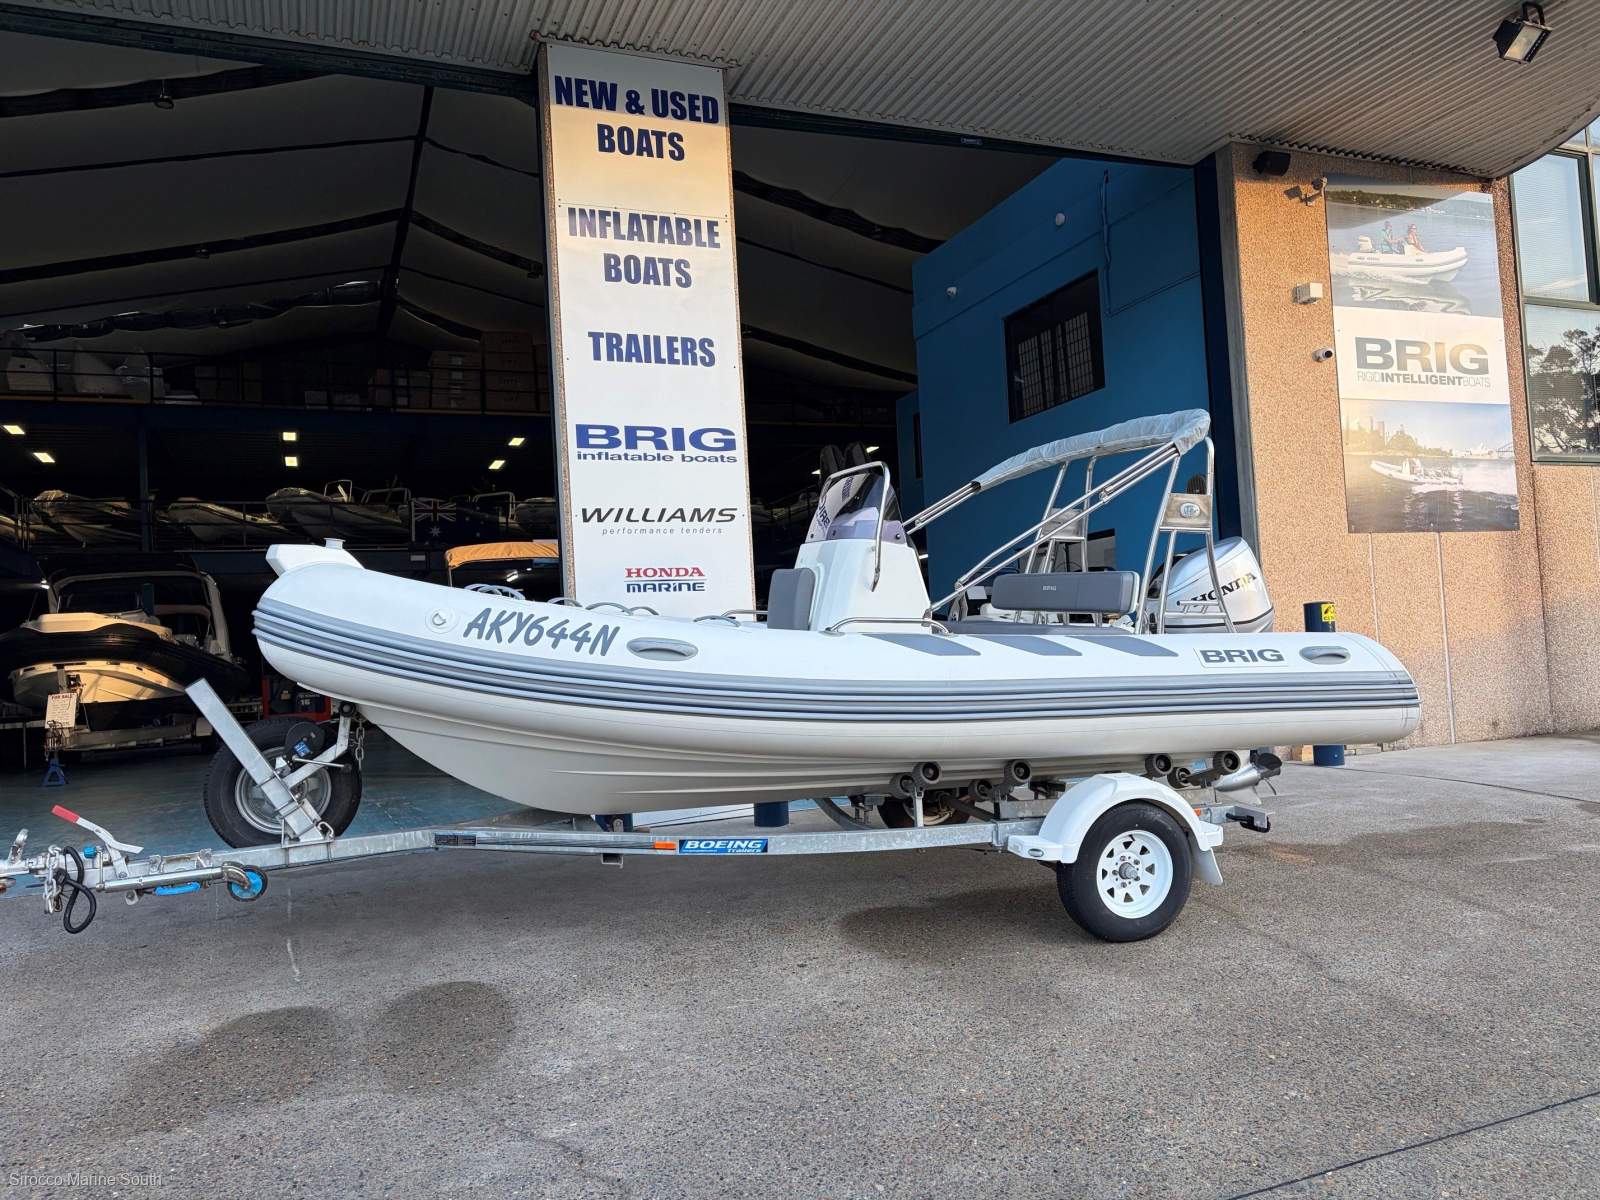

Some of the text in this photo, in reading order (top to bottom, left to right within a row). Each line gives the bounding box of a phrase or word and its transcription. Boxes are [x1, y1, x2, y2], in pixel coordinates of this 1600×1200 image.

[554, 75, 719, 124] NEW & USED
[596, 123, 685, 161] BOATS
[567, 207, 721, 249] INFLATABLE
[603, 253, 692, 288] BOATS
[587, 331, 716, 368] TRAILERS
[1355, 336, 1490, 375] BRIG
[576, 424, 736, 451] BRIG
[577, 451, 738, 463] inflatable boats
[581, 507, 738, 523] WILLIAMS
[602, 527, 723, 536] performance tenders
[625, 567, 705, 578] HONDA
[463, 607, 620, 657] AKY644N
[1200, 648, 1284, 663] BRIG
[685, 840, 763, 849] BOEING
